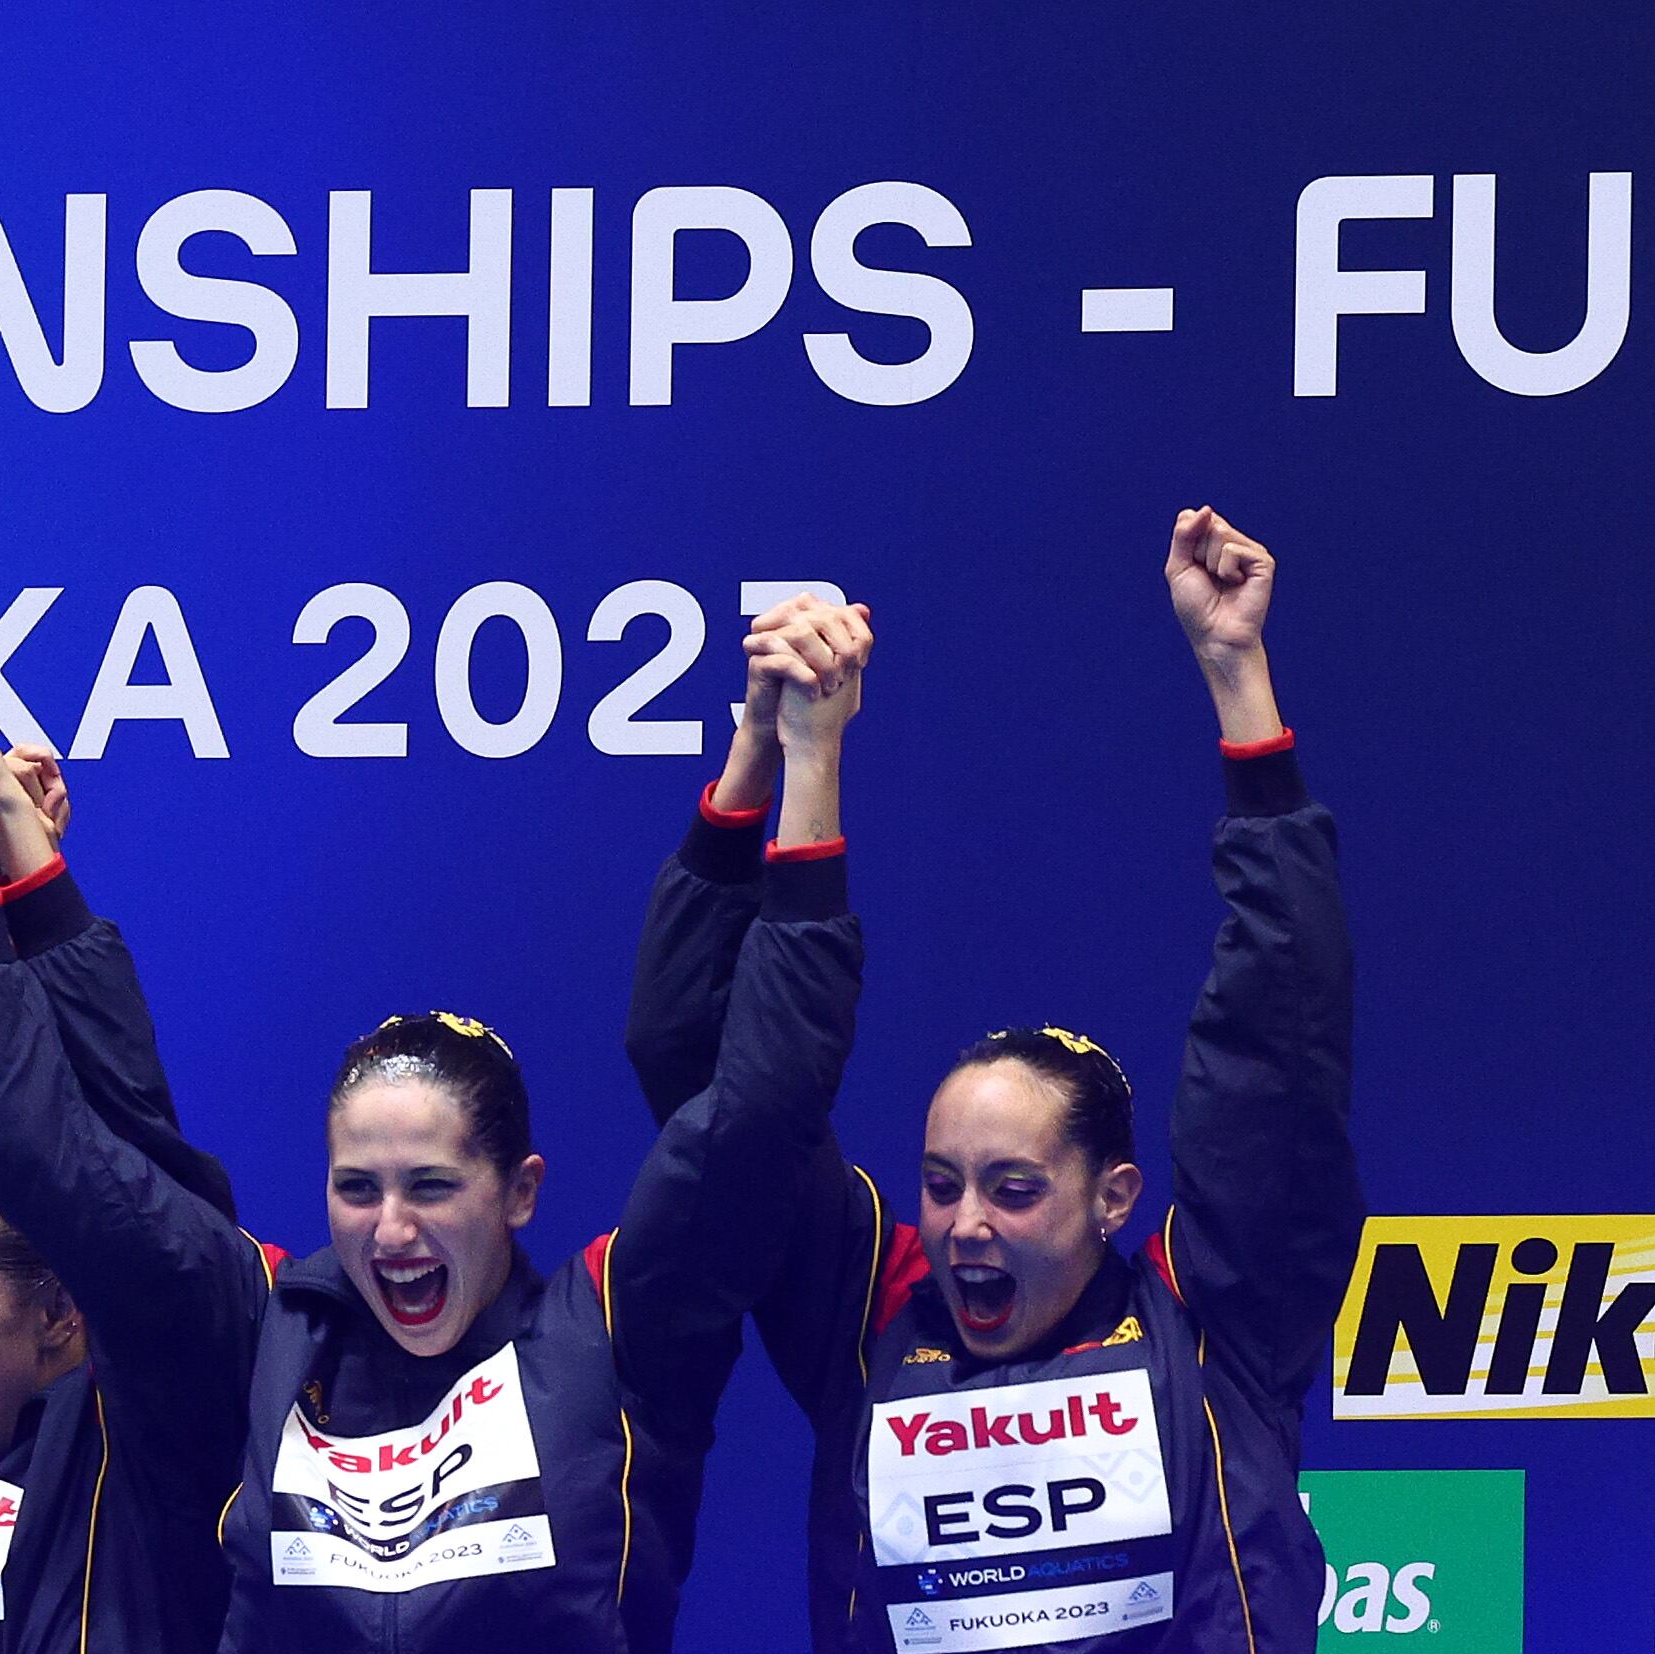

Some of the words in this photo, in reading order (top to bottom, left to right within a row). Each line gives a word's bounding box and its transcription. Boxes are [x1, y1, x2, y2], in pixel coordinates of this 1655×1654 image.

[295, 1375, 505, 1474] Yakult
[886, 1392, 1139, 1457] Yakult
[328, 1443, 474, 1528] ESP
[923, 1476, 1107, 1547] ESP
[429, 1542, 484, 1564] 2023
[948, 1565, 1026, 1588] WORLD
[1028, 1553, 1130, 1578] AQUATICS
[949, 1609, 1050, 1632] FUKUOKA
[1055, 1602, 1110, 1621] 2023
